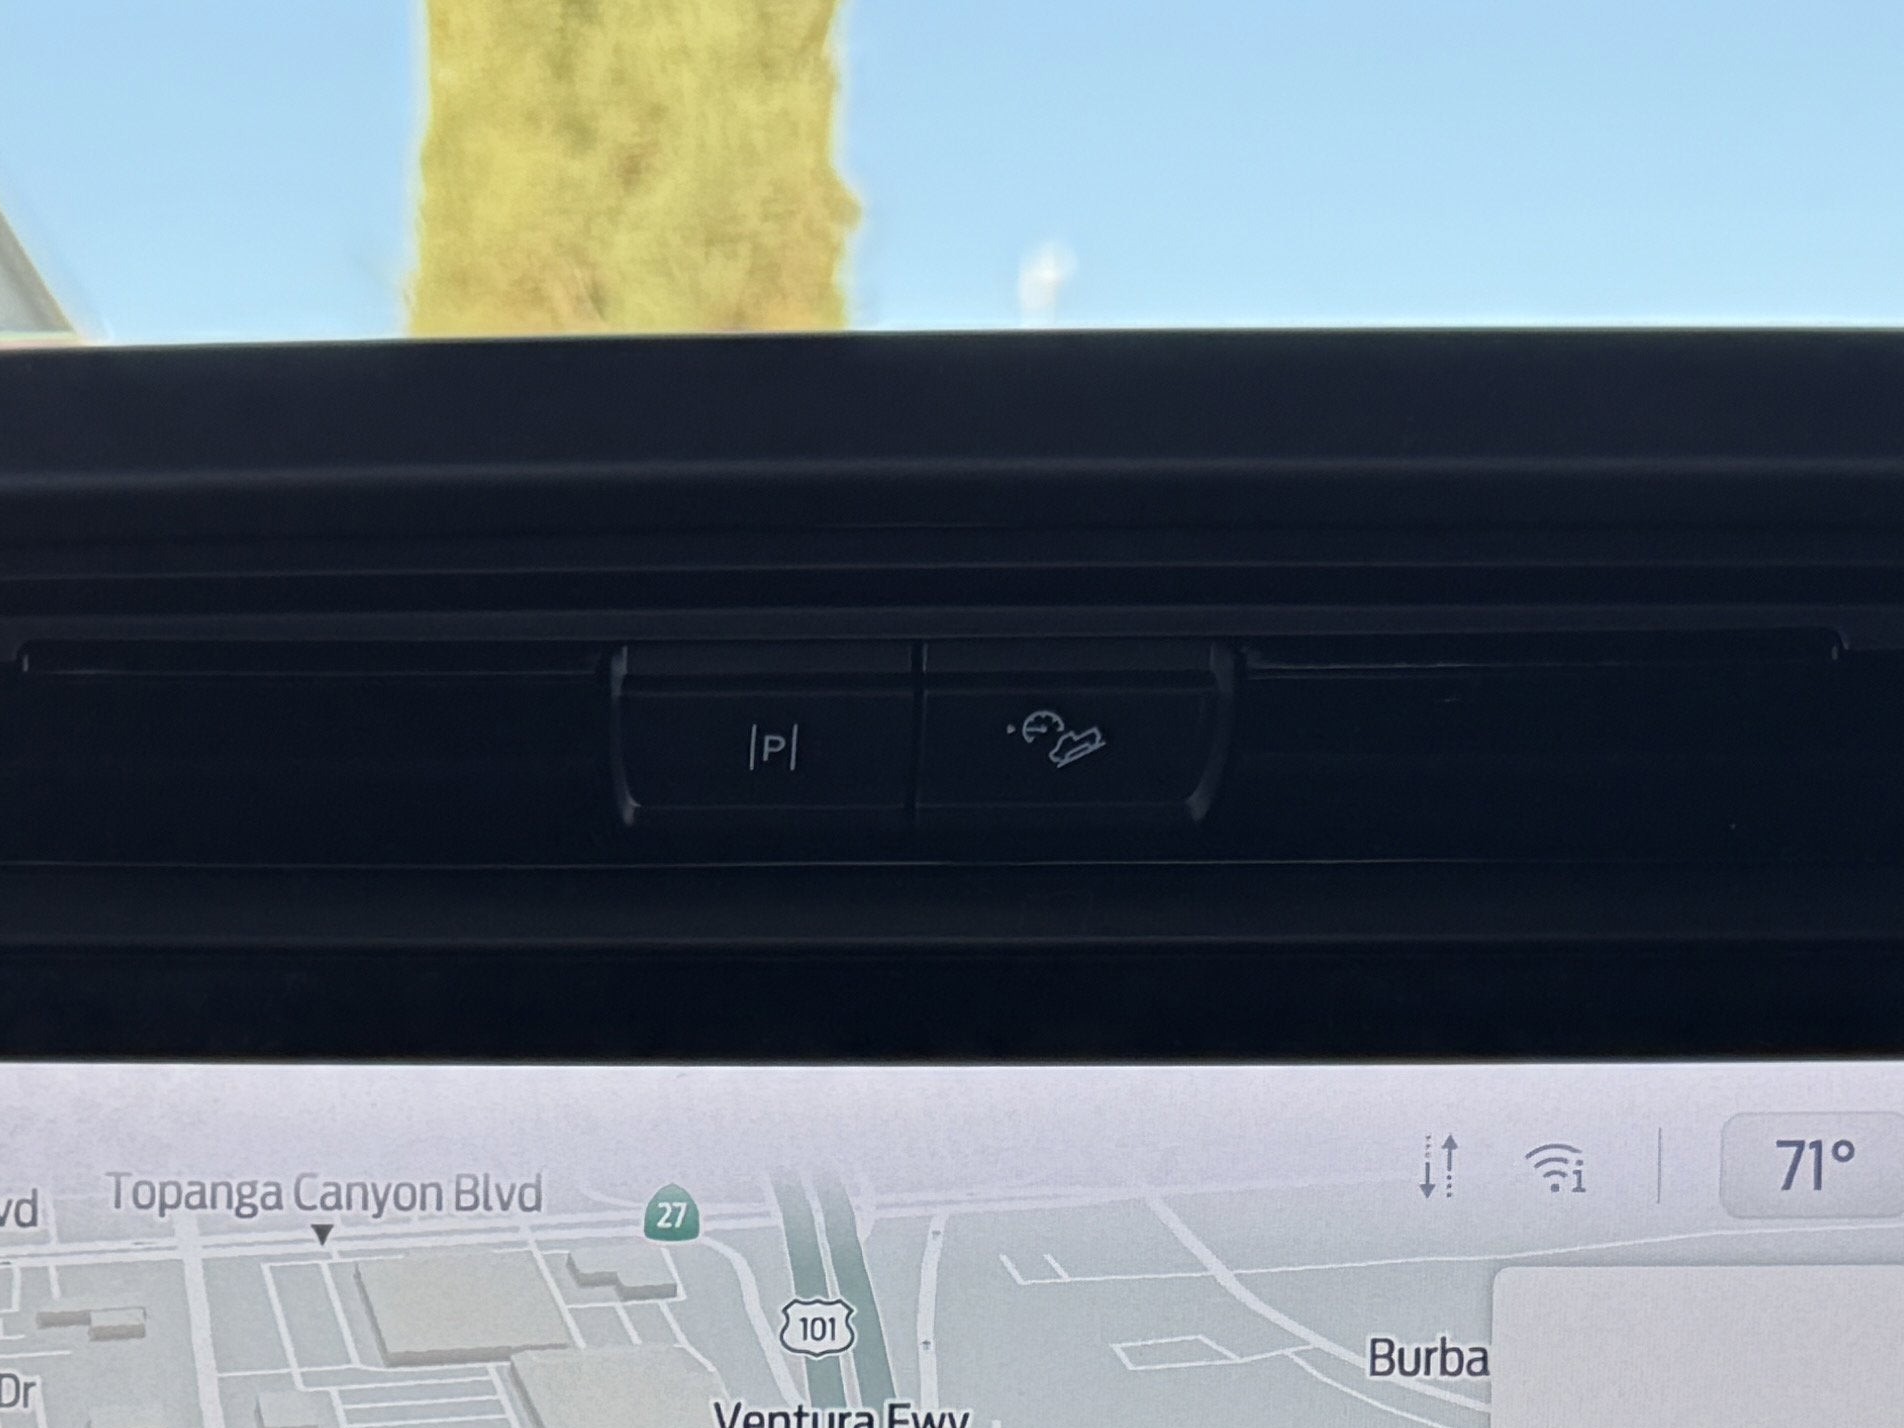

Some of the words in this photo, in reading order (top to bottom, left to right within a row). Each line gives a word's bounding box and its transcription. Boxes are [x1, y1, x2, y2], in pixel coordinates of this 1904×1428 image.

[1775, 1138, 1856, 1193] 71°
[105, 1171, 283, 1215] Topanga
[295, 1172, 444, 1216] Canyon
[455, 1173, 543, 1213] Blvd
[656, 1202, 686, 1229] 27
[800, 1317, 837, 1342] 101
